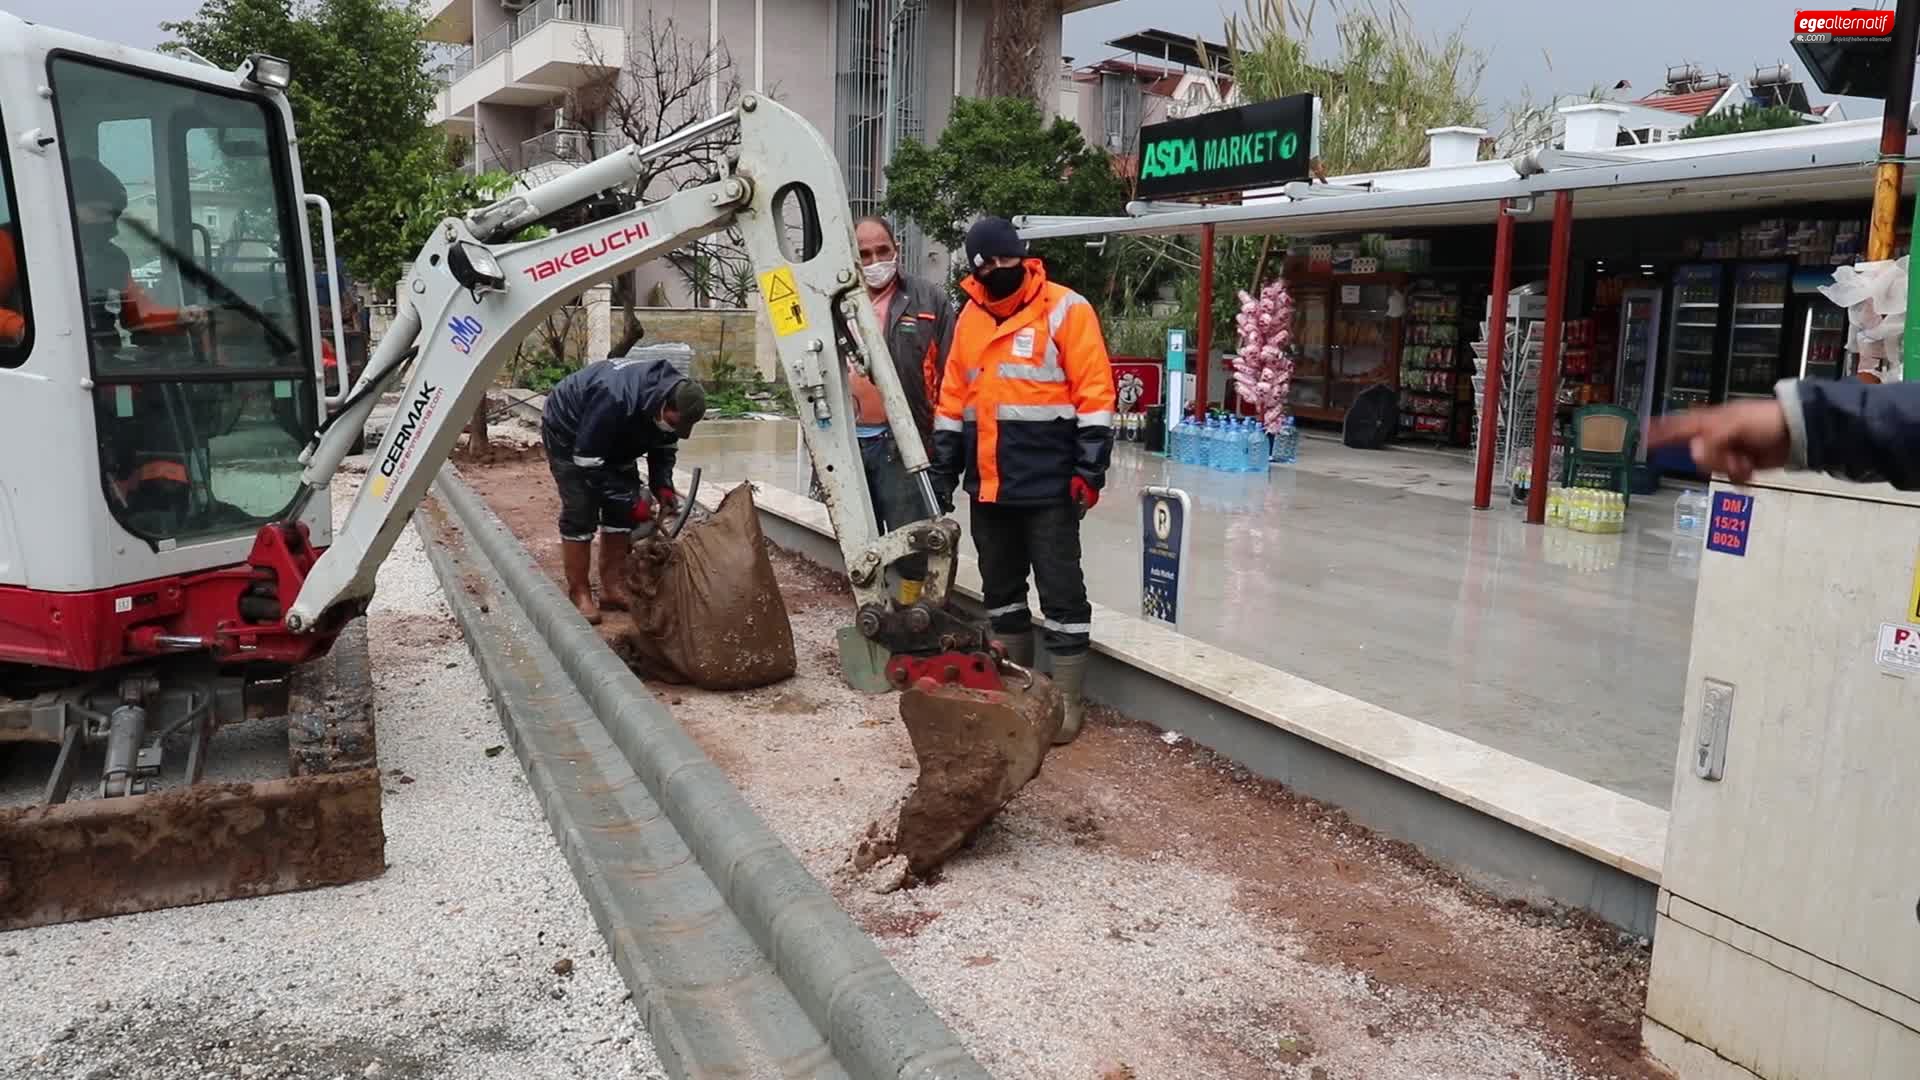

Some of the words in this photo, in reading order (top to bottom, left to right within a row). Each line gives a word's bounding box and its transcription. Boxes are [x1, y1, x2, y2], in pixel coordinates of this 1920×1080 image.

[1141, 137, 1199, 180] ASDA
[1203, 130, 1278, 171] MARKET
[523, 221, 650, 283] TAKEUCHI
[380, 380, 436, 477] CERMAK
[1714, 515, 1746, 532] 15/21
